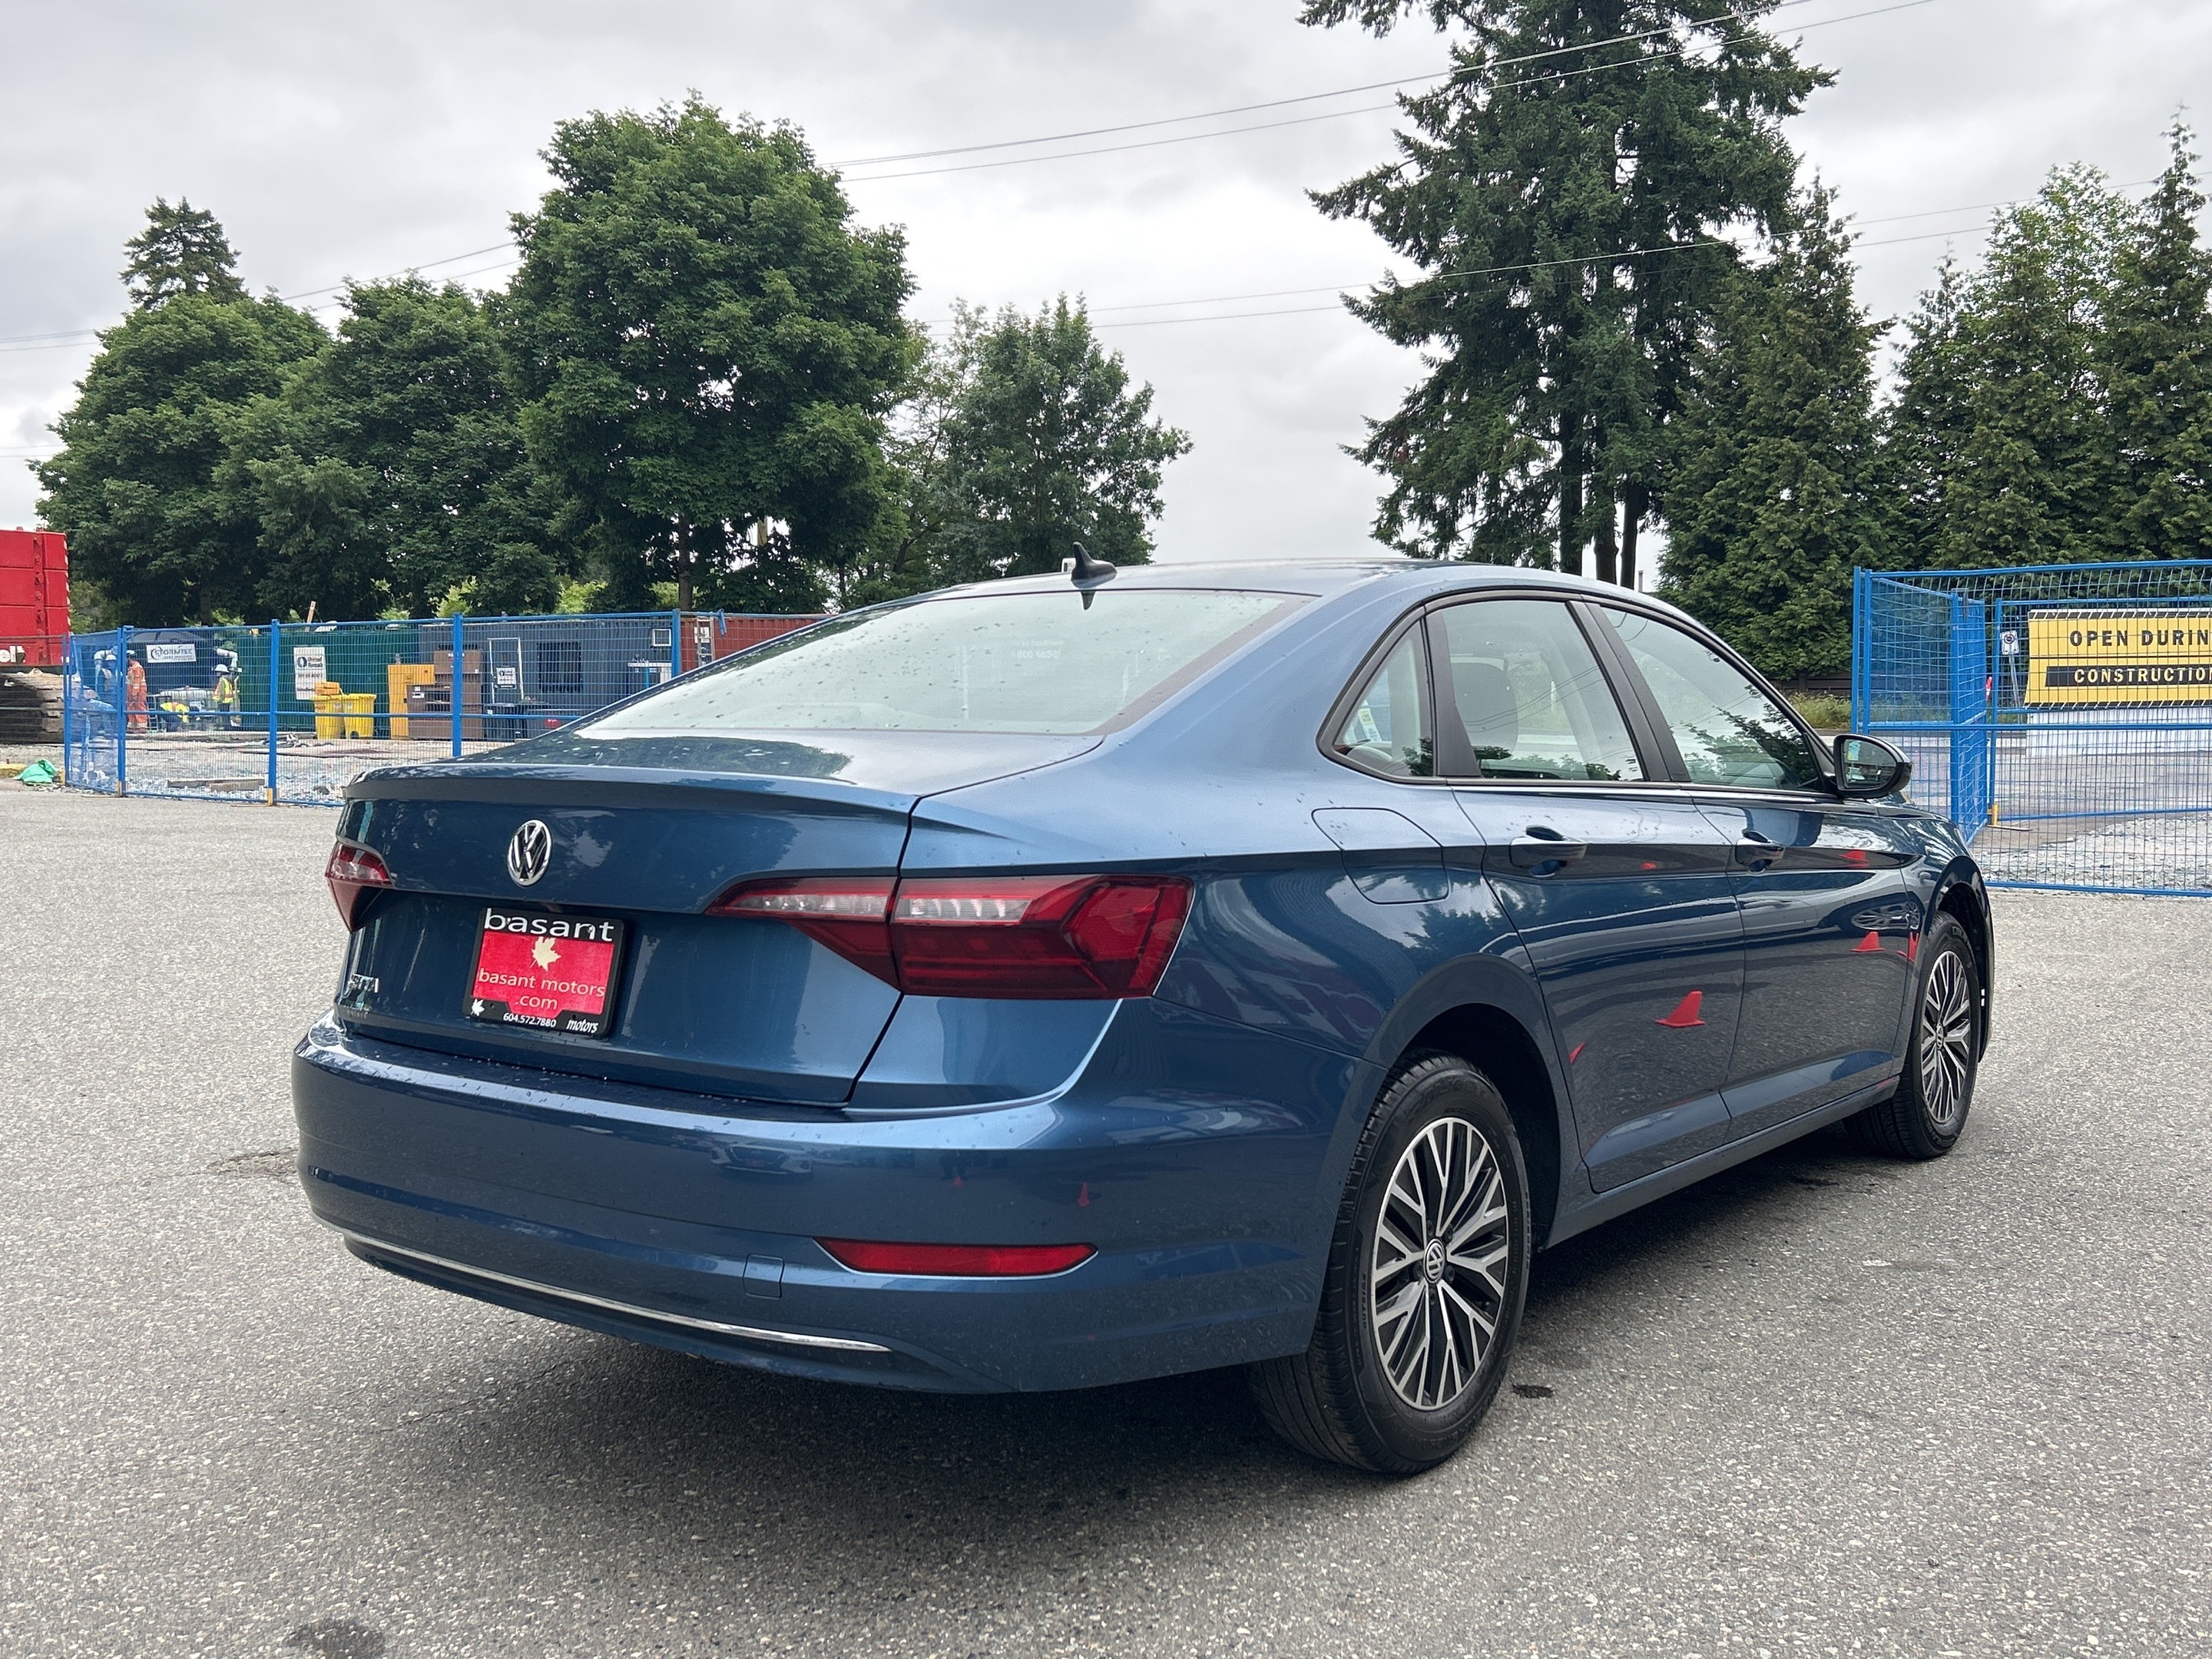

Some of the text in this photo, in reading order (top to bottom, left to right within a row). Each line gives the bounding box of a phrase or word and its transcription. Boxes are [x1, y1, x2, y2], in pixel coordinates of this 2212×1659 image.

[2070, 629, 2209, 647] OPEN DURIN
[2075, 667, 2212, 683] CONSTRUCTIO
[484, 908, 614, 942] basant
[478, 968, 606, 997] basant motors
[515, 995, 558, 1010] .com
[503, 1012, 557, 1028] 604.572.7880
[566, 1018, 599, 1034] motors
